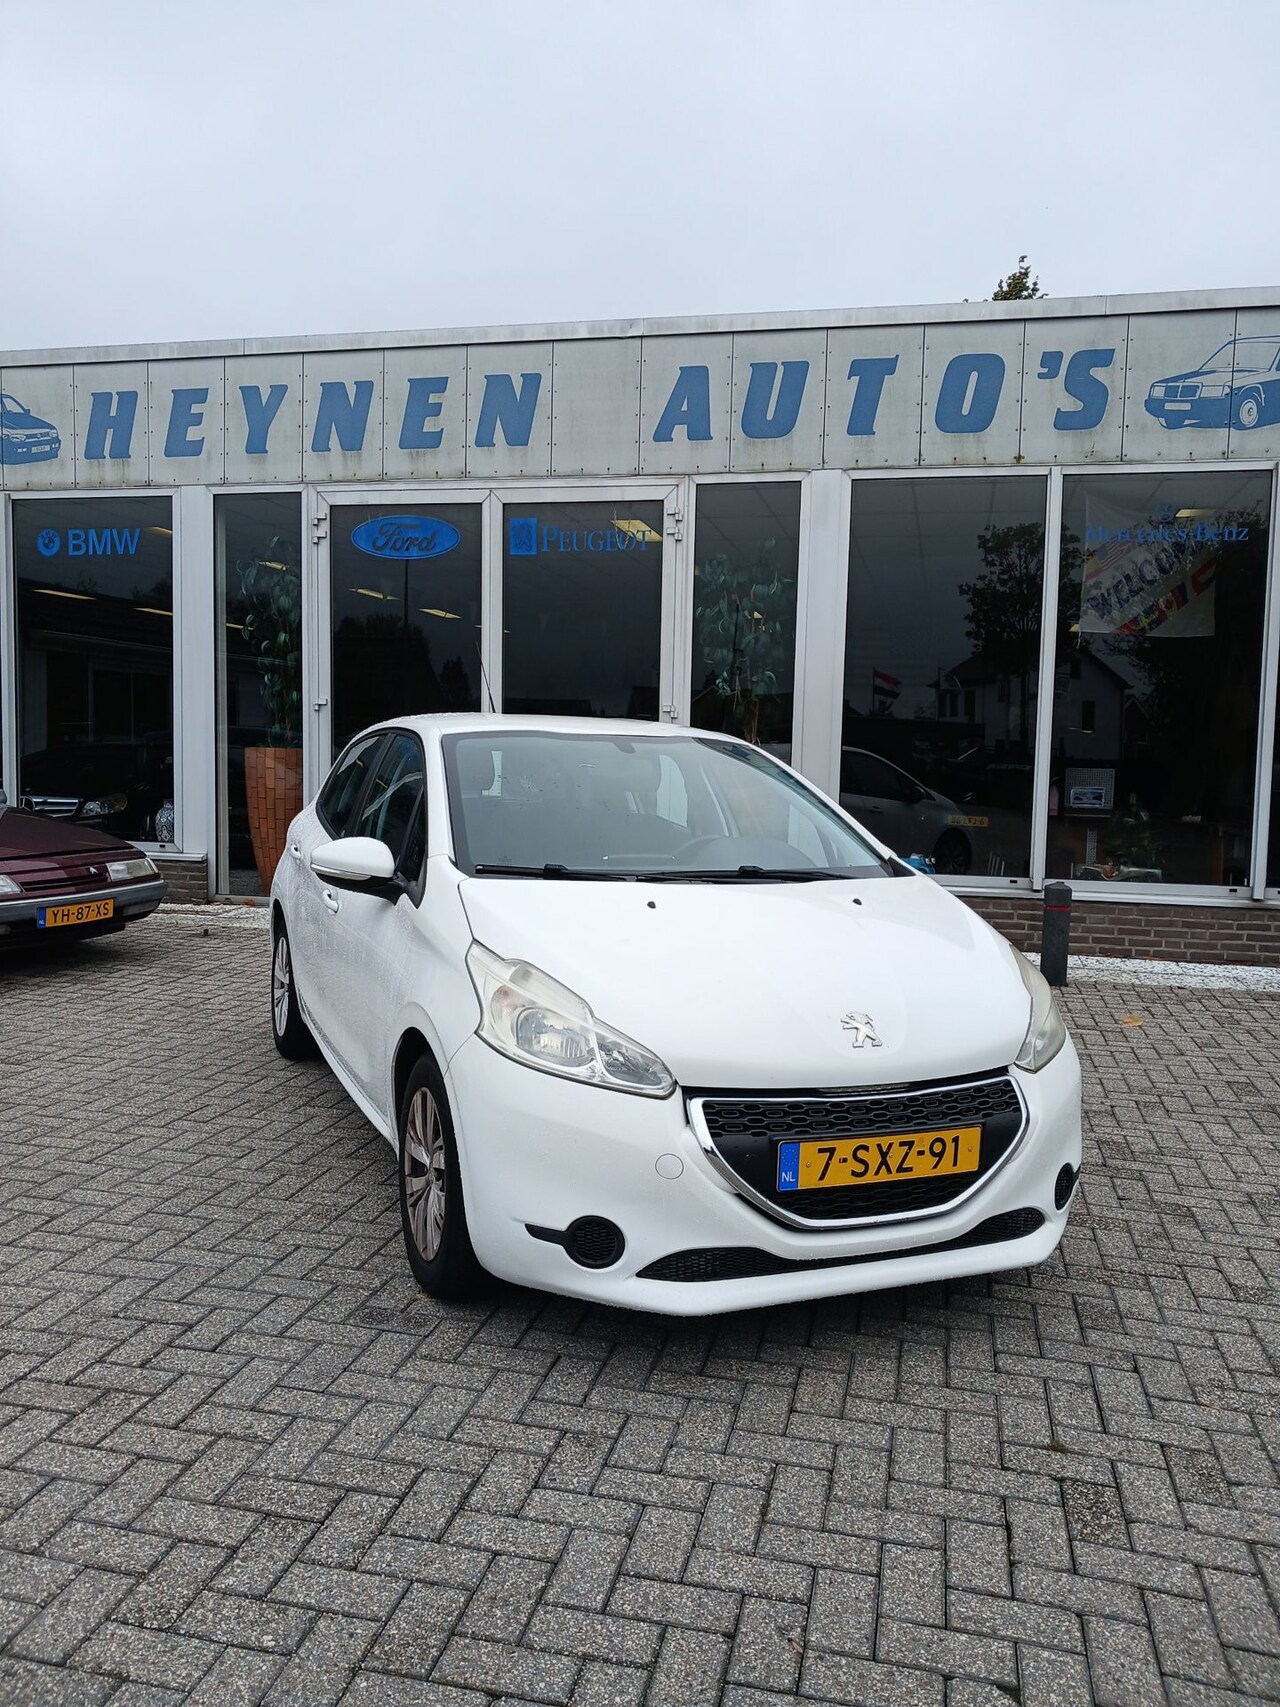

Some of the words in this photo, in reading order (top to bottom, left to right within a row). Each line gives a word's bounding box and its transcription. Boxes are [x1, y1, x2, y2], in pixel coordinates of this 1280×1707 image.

[84, 373, 542, 460] HEYNEN
[653, 348, 1116, 442] AUTO'S
[67, 528, 141, 556] BMW
[371, 522, 439, 552] Ford
[1086, 532, 1206, 621] WELCO
[52, 902, 109, 923] YH-87-XS
[781, 1171, 796, 1182] NL
[817, 1135, 960, 1181] 7-SXZ-91
